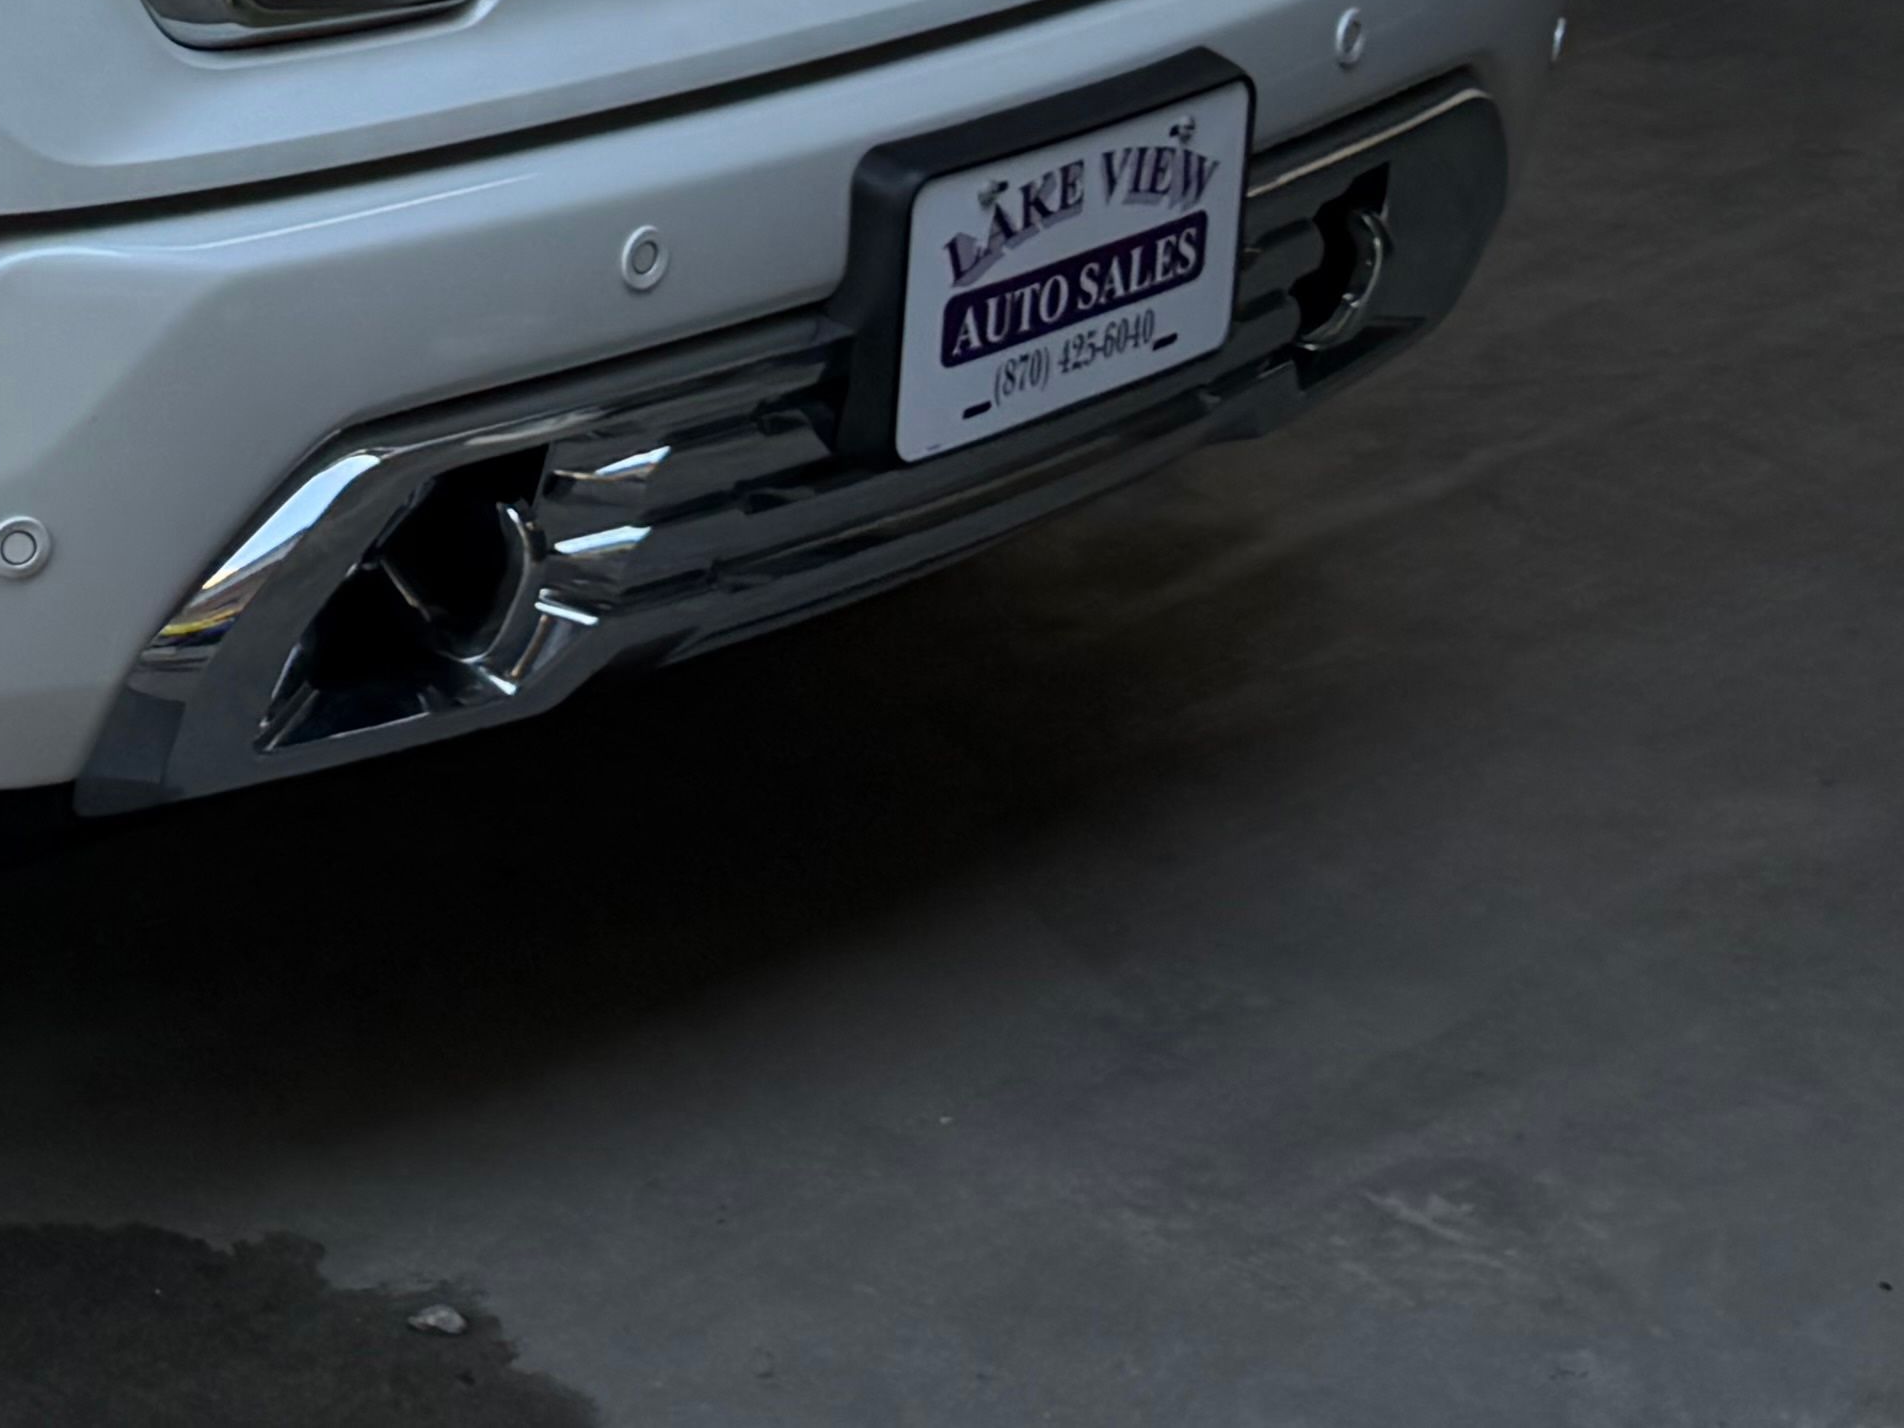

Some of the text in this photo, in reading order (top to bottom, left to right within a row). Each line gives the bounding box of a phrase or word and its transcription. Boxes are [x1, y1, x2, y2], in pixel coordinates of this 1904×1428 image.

[943, 146, 1220, 287] LAKE VIEW
[952, 227, 1198, 358] AUTO SALES
[994, 308, 1156, 406] (870) 425-6040
